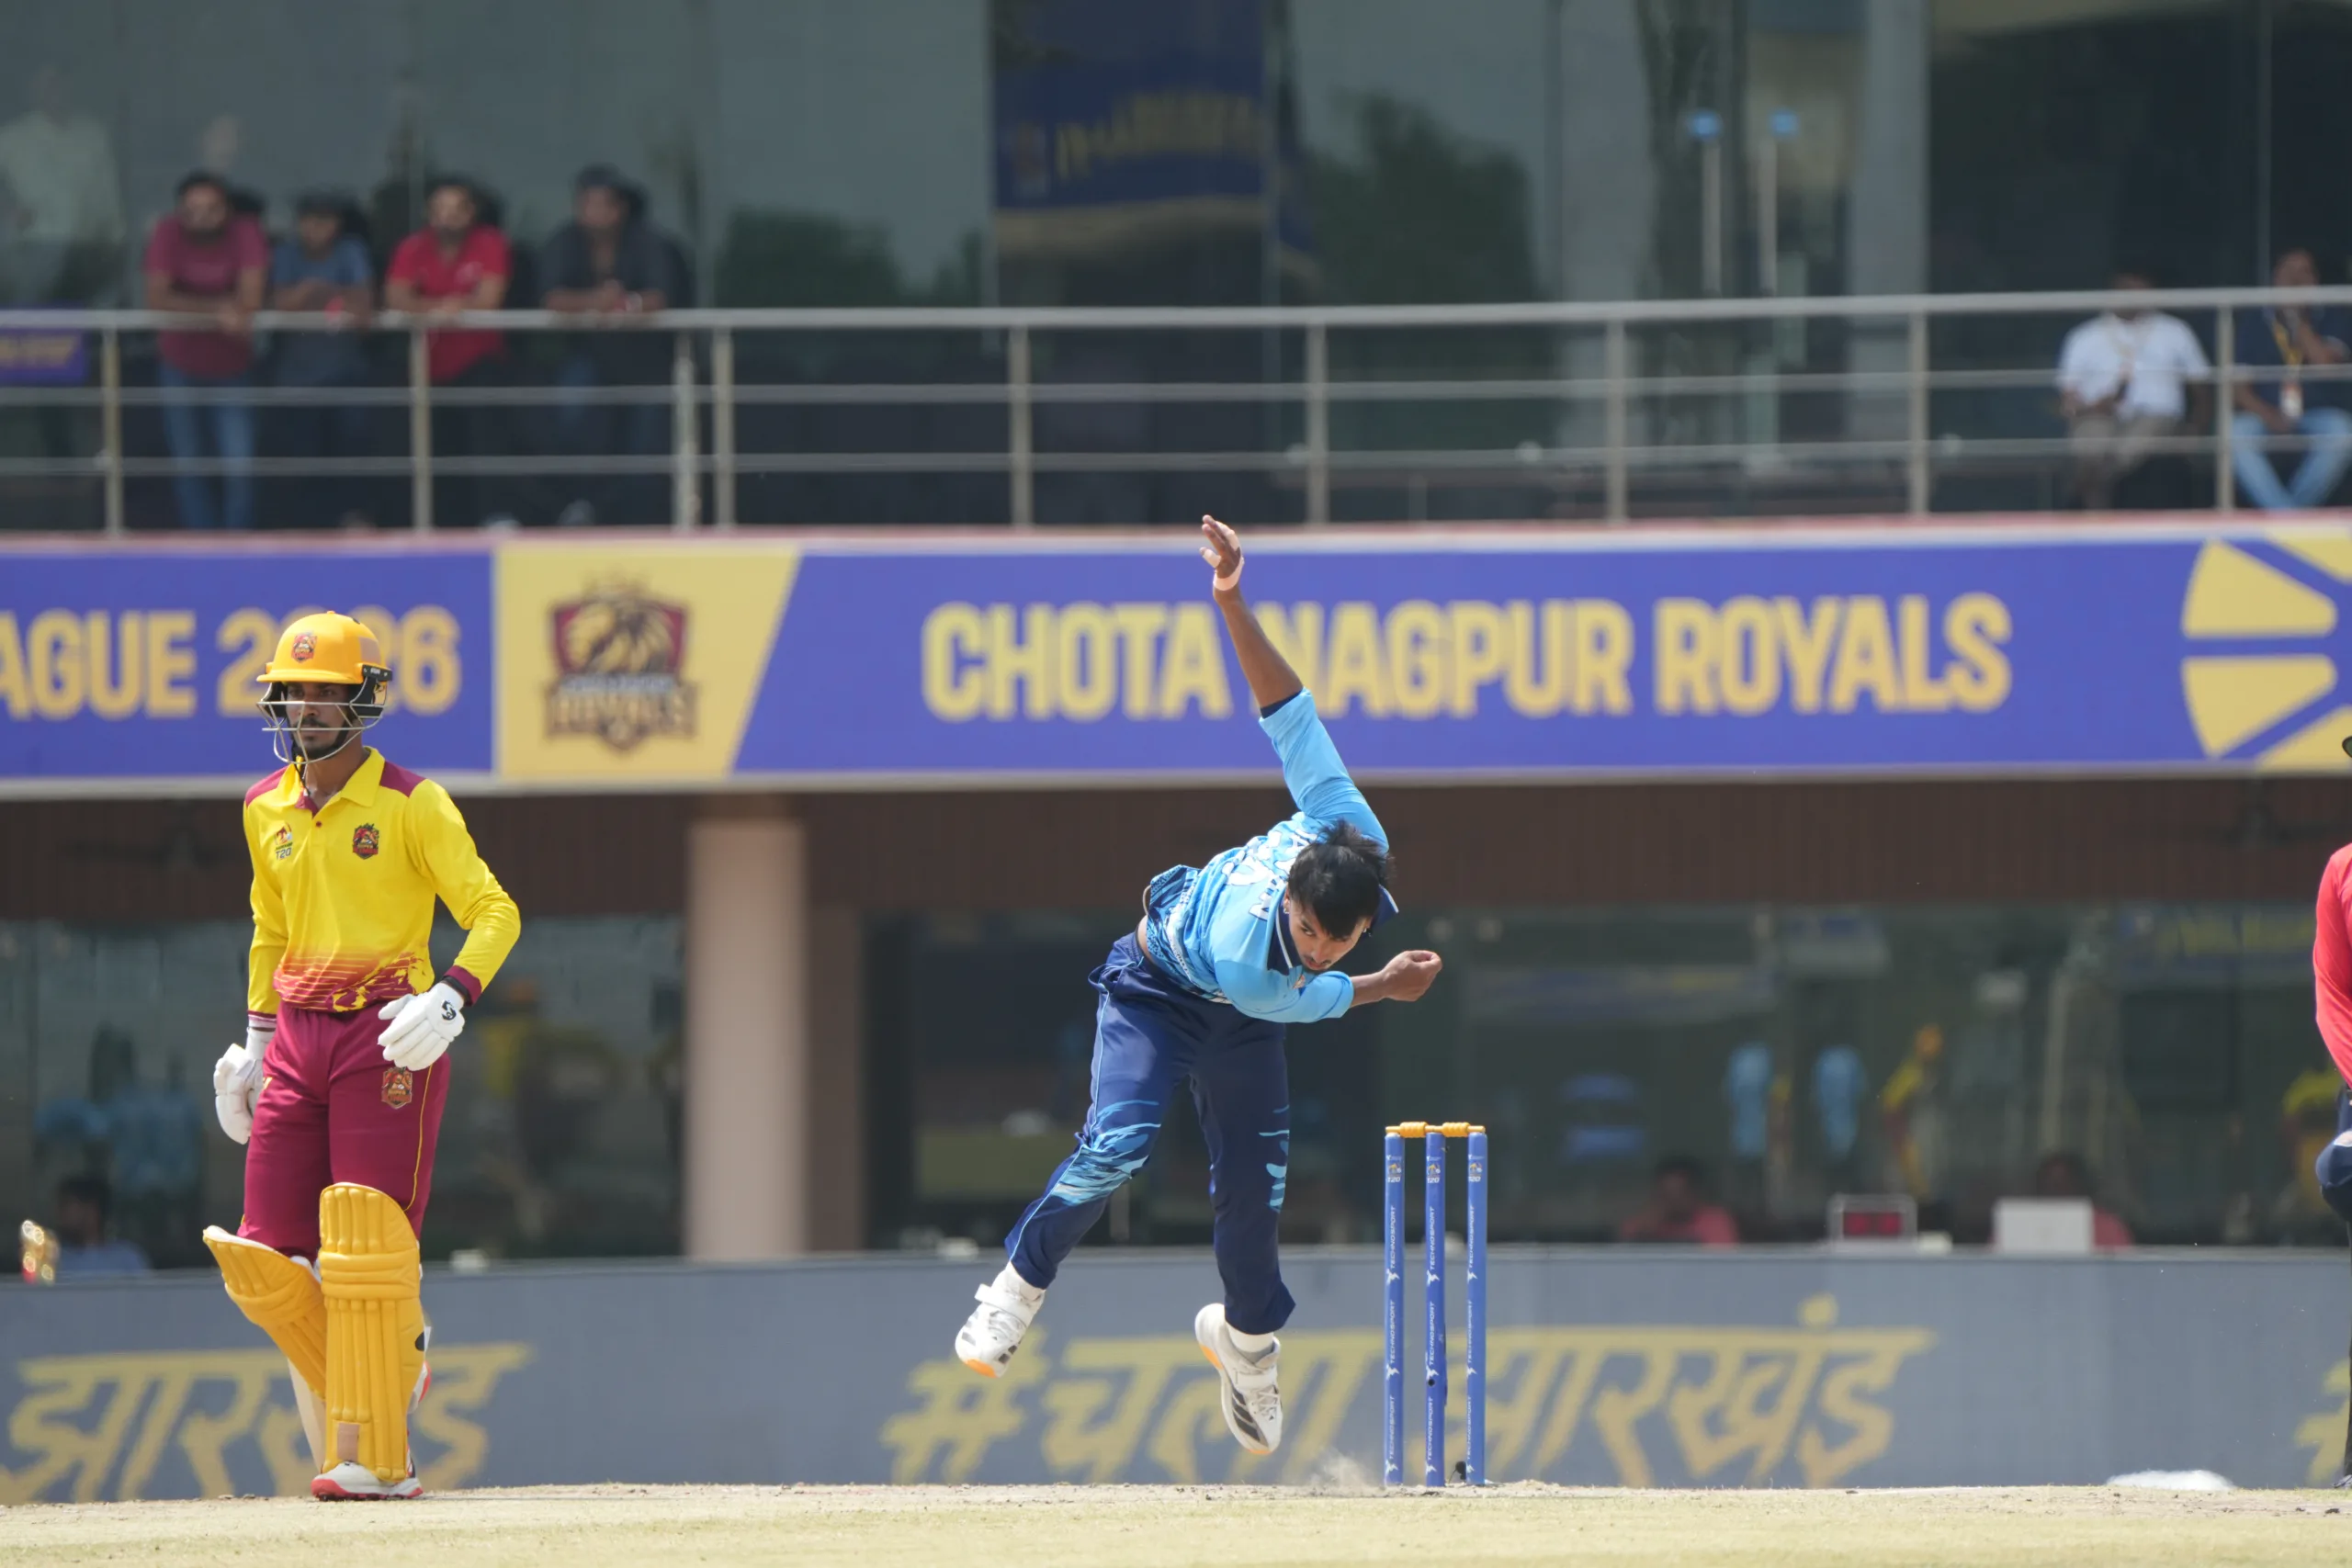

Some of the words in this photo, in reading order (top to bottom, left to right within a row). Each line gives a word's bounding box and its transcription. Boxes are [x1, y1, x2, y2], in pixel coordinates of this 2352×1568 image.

[217, 604, 462, 718] 26
[922, 601, 1233, 720] CHOTA
[1655, 592, 2012, 716] ROYALS
[276, 847, 292, 860] T20
